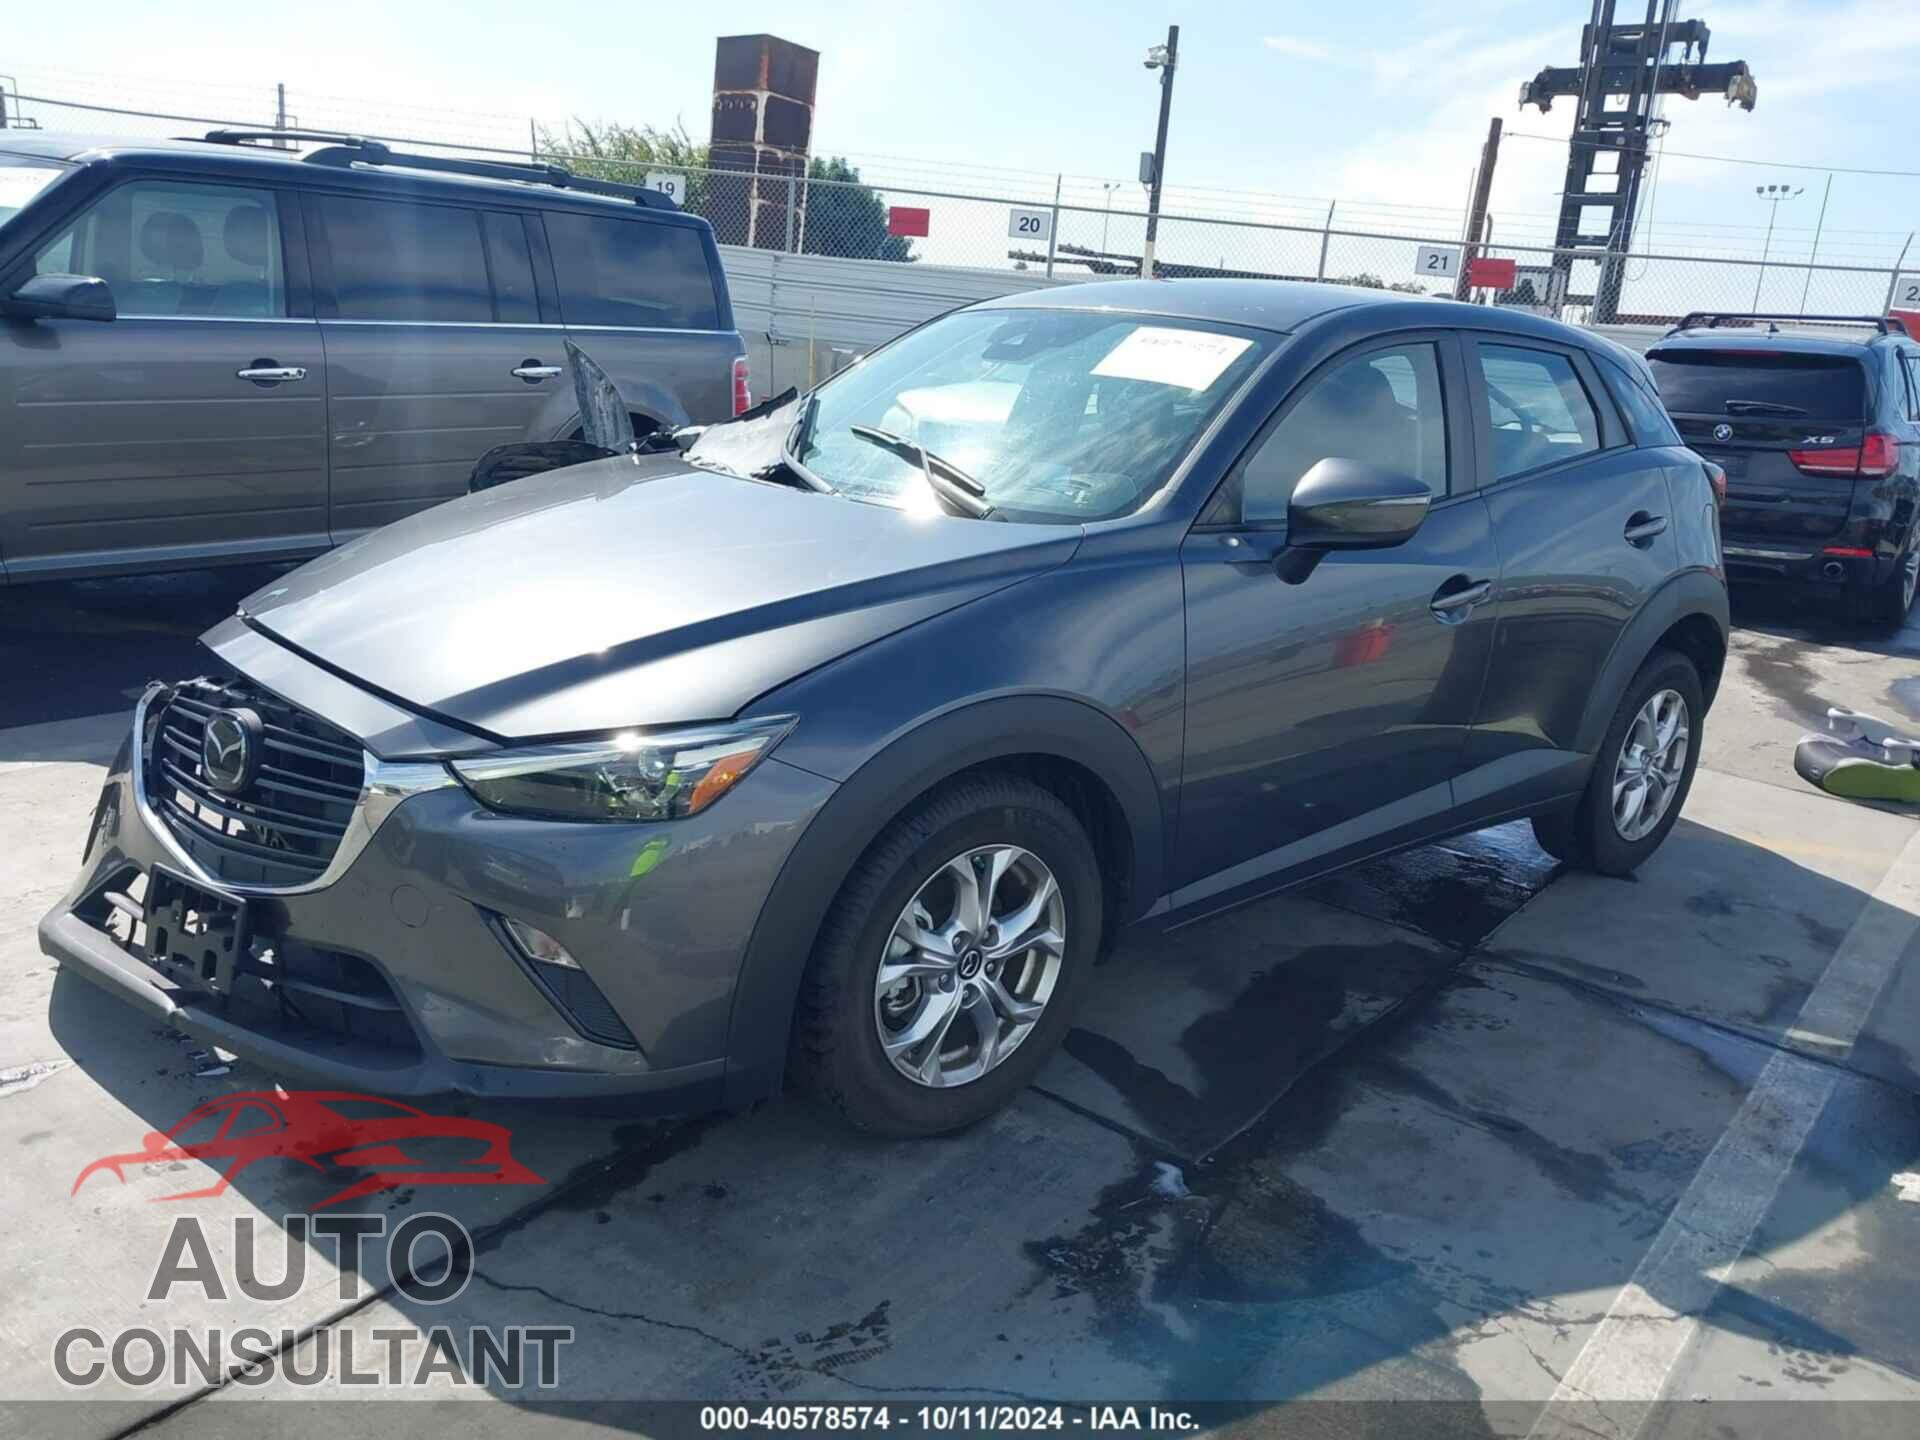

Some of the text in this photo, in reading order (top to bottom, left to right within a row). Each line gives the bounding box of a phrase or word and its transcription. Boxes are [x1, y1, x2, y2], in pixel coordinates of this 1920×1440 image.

[656, 181, 676, 196] 19
[1019, 217, 1041, 233] 20
[1427, 254, 1448, 270] 21
[1905, 286, 1920, 301] 2
[1802, 435, 1836, 444] X5
